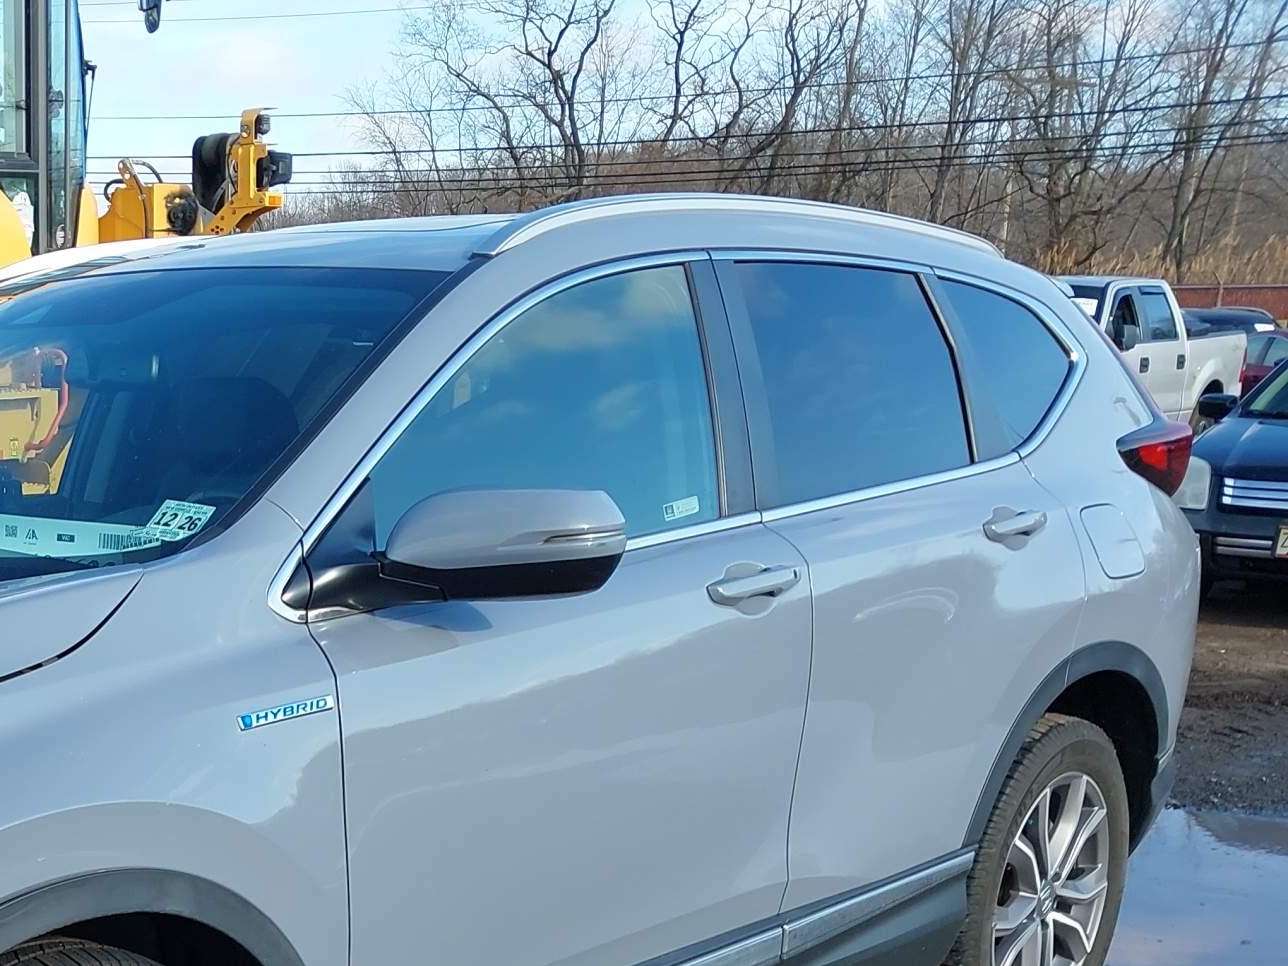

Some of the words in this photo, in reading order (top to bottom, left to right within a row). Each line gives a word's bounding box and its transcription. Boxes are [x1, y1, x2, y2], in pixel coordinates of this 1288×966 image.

[153, 511, 179, 527] 12
[177, 515, 202, 531] 26
[255, 698, 328, 723] HYBRID
